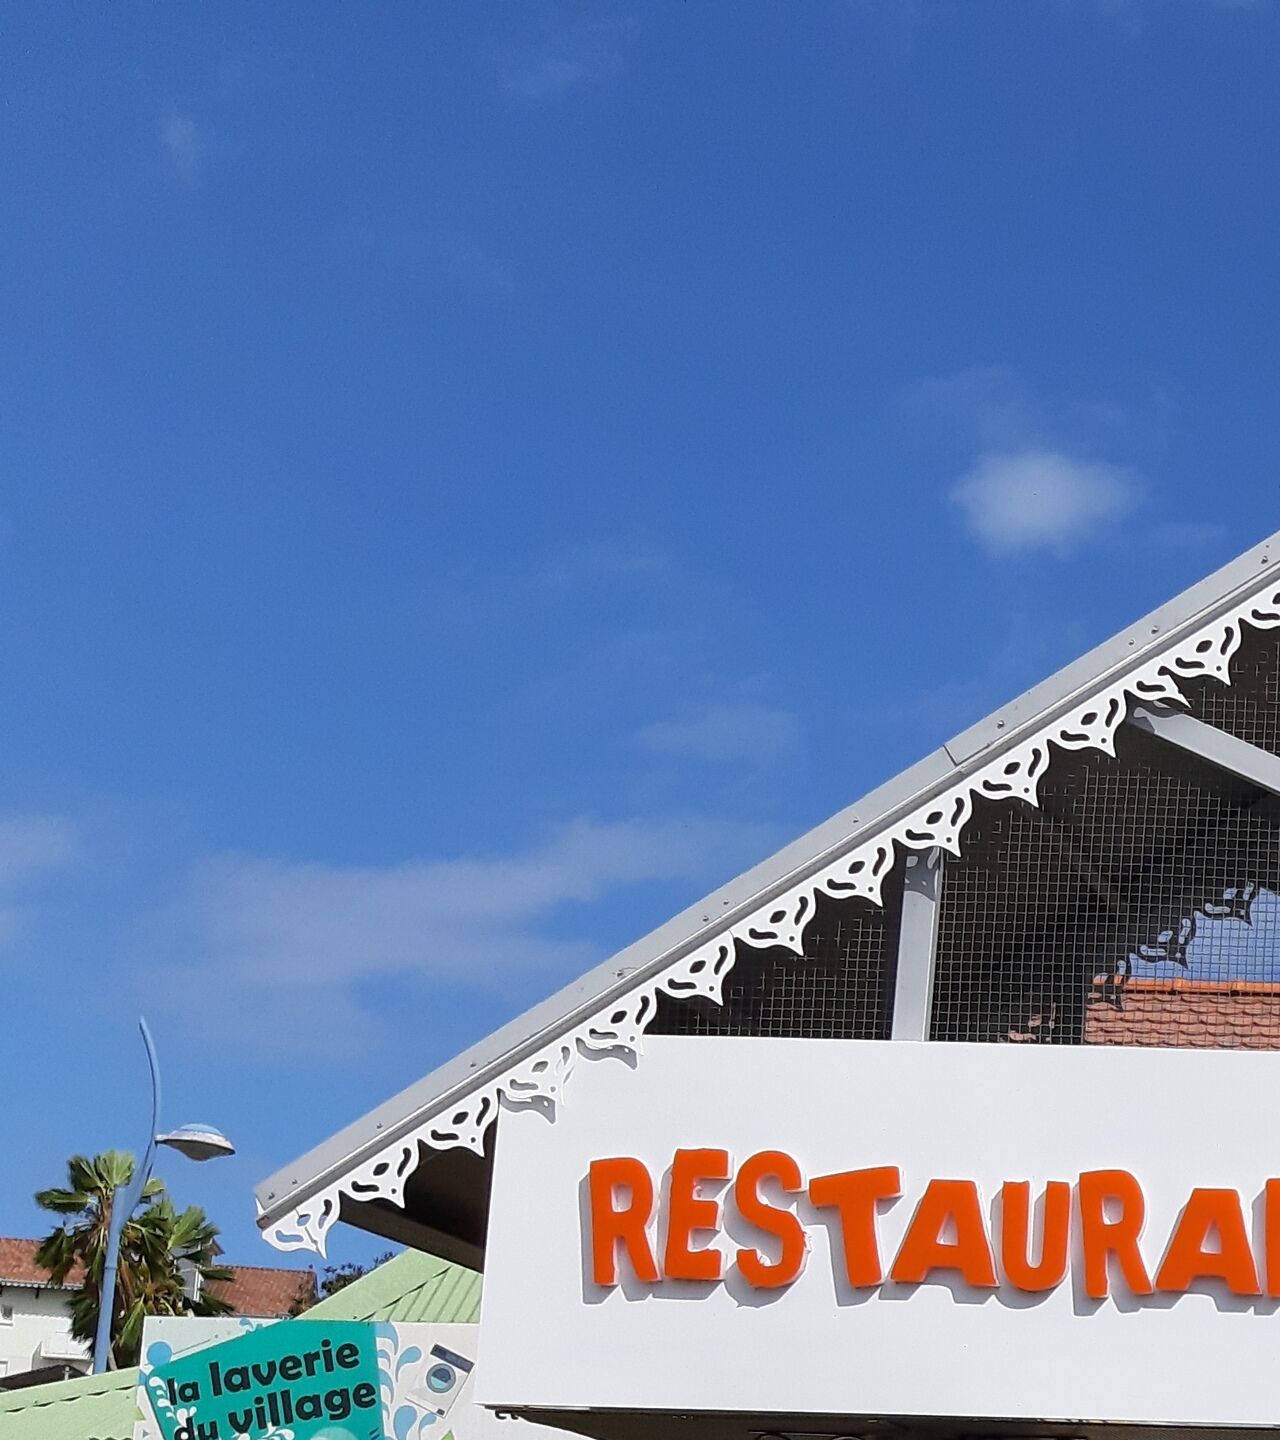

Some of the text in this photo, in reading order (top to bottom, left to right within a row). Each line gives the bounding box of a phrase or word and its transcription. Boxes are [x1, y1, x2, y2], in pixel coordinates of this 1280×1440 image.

[167, 1338, 361, 1405] la laverie
[227, 1381, 377, 1435] village
